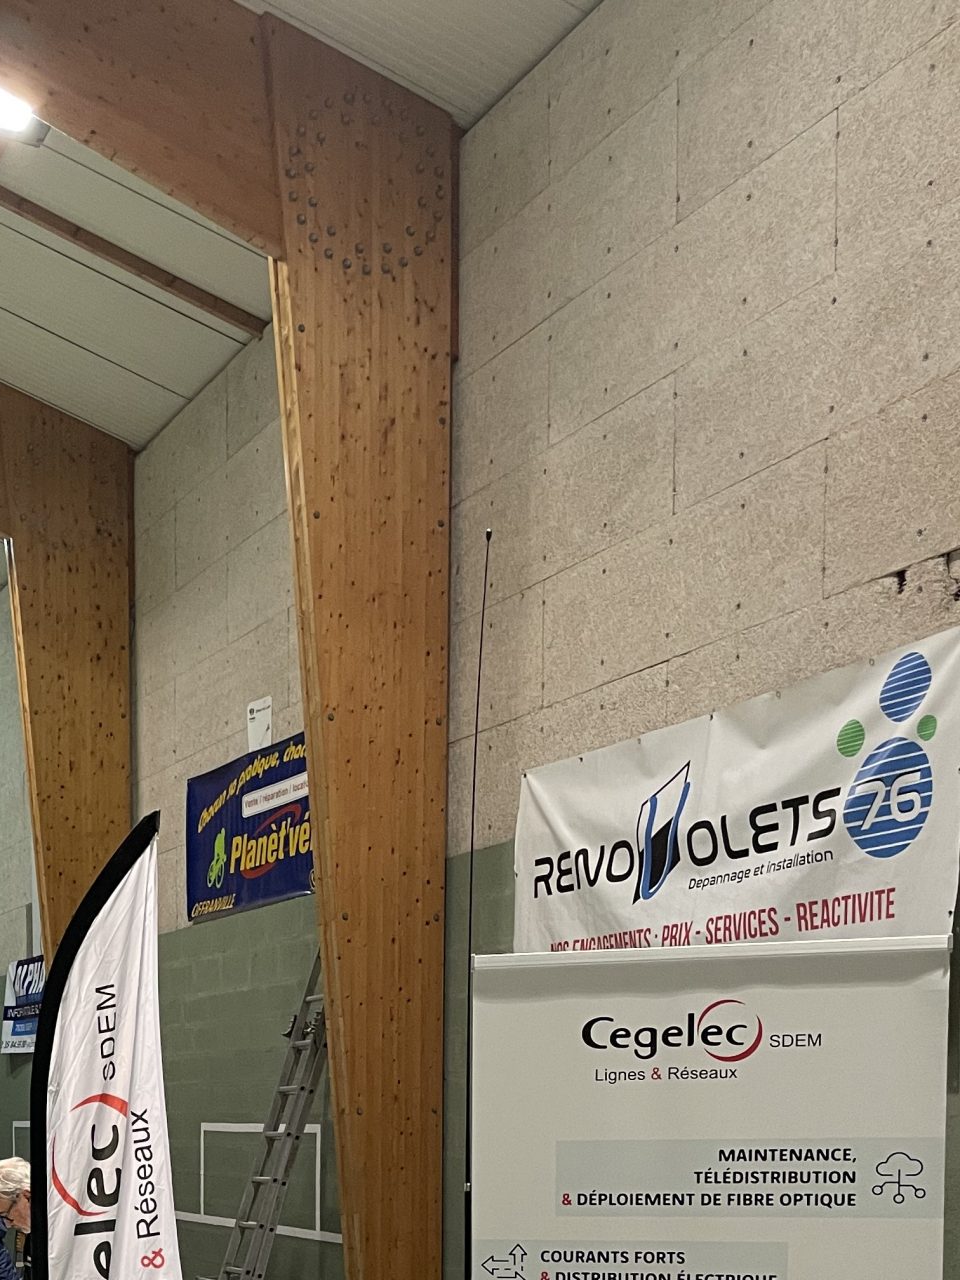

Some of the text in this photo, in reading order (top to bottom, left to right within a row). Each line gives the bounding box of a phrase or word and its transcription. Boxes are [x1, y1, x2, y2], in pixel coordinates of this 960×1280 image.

[854, 768, 923, 832] 76
[230, 811, 313, 874] Planèt'vé
[689, 850, 834, 890] Depannage et installation
[661, 920, 694, 946] PRIX
[705, 907, 780, 945] SERVICES
[795, 887, 896, 932] REACTIVITE
[96, 984, 117, 1081] SDEM
[581, 1012, 822, 1060] Cegelec SDEM
[595, 1066, 738, 1085] Lignes & Réseaux
[131, 1108, 161, 1239] Réseaux
[694, 1167, 857, 1184] TÉLÉDISTRIBUTION
[718, 1148, 857, 1163] MAINTENANCE,
[562, 1190, 857, 1209] & DÉPLOIEMENT DE FIBRE OPTIQUE
[140, 1247, 165, 1269] &
[540, 1250, 686, 1264] COURANTS FORTS
